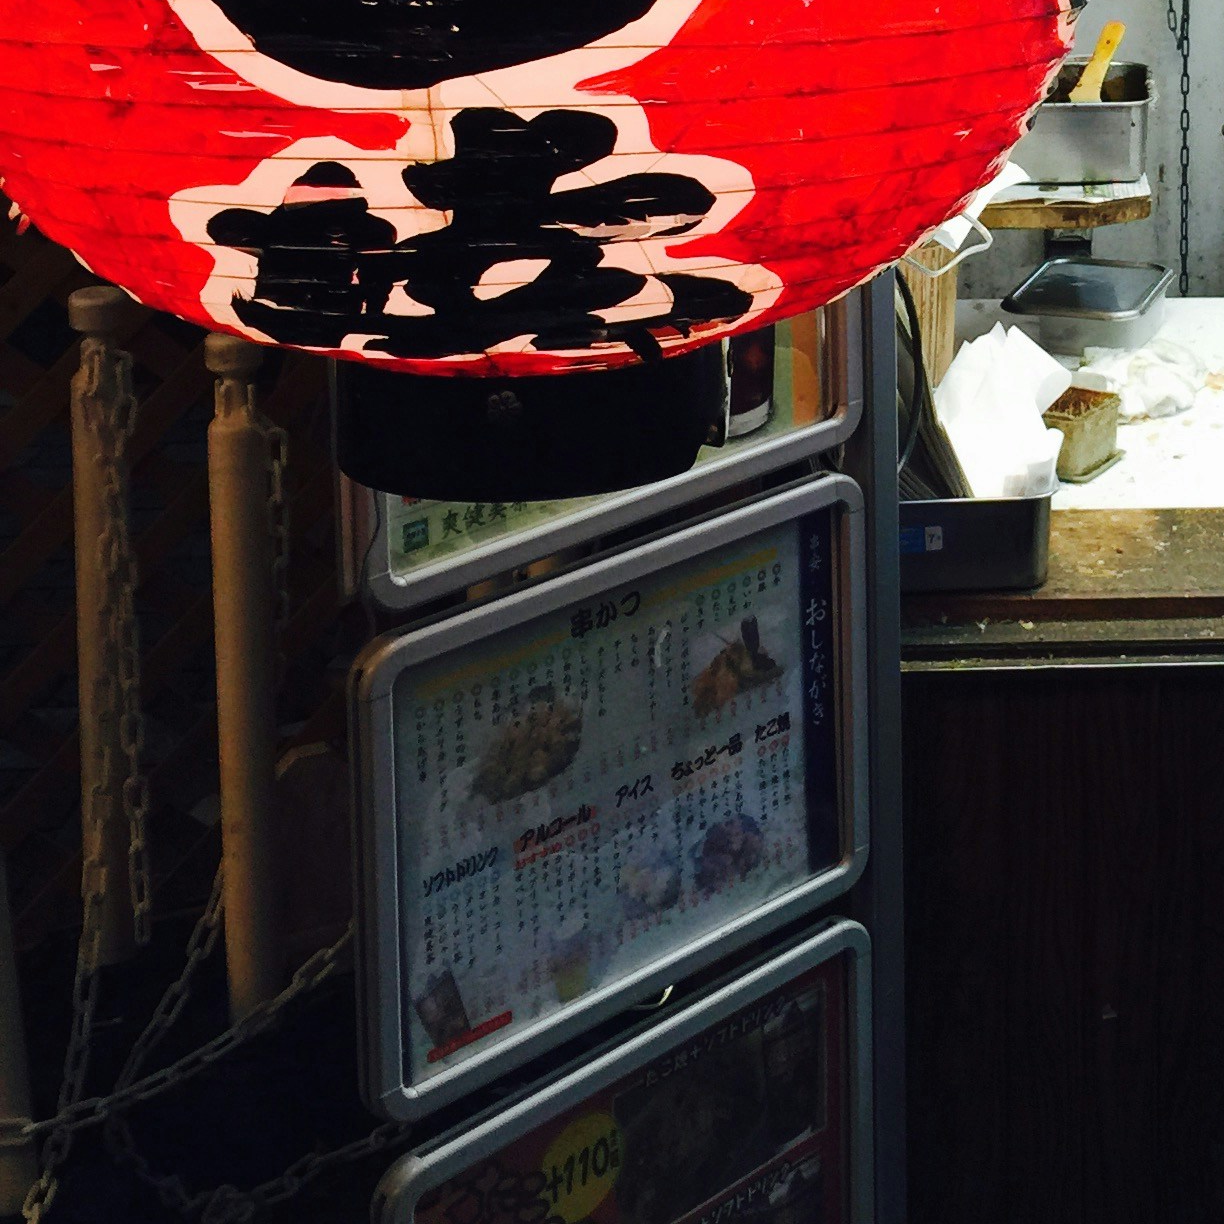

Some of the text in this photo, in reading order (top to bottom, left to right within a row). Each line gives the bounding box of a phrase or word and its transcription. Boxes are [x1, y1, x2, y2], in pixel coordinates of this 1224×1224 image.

[570, 591, 641, 639] 串かつ
[805, 598, 828, 725] おしながき
[615, 774, 655, 808] アイス
[519, 803, 593, 853] アルコール
